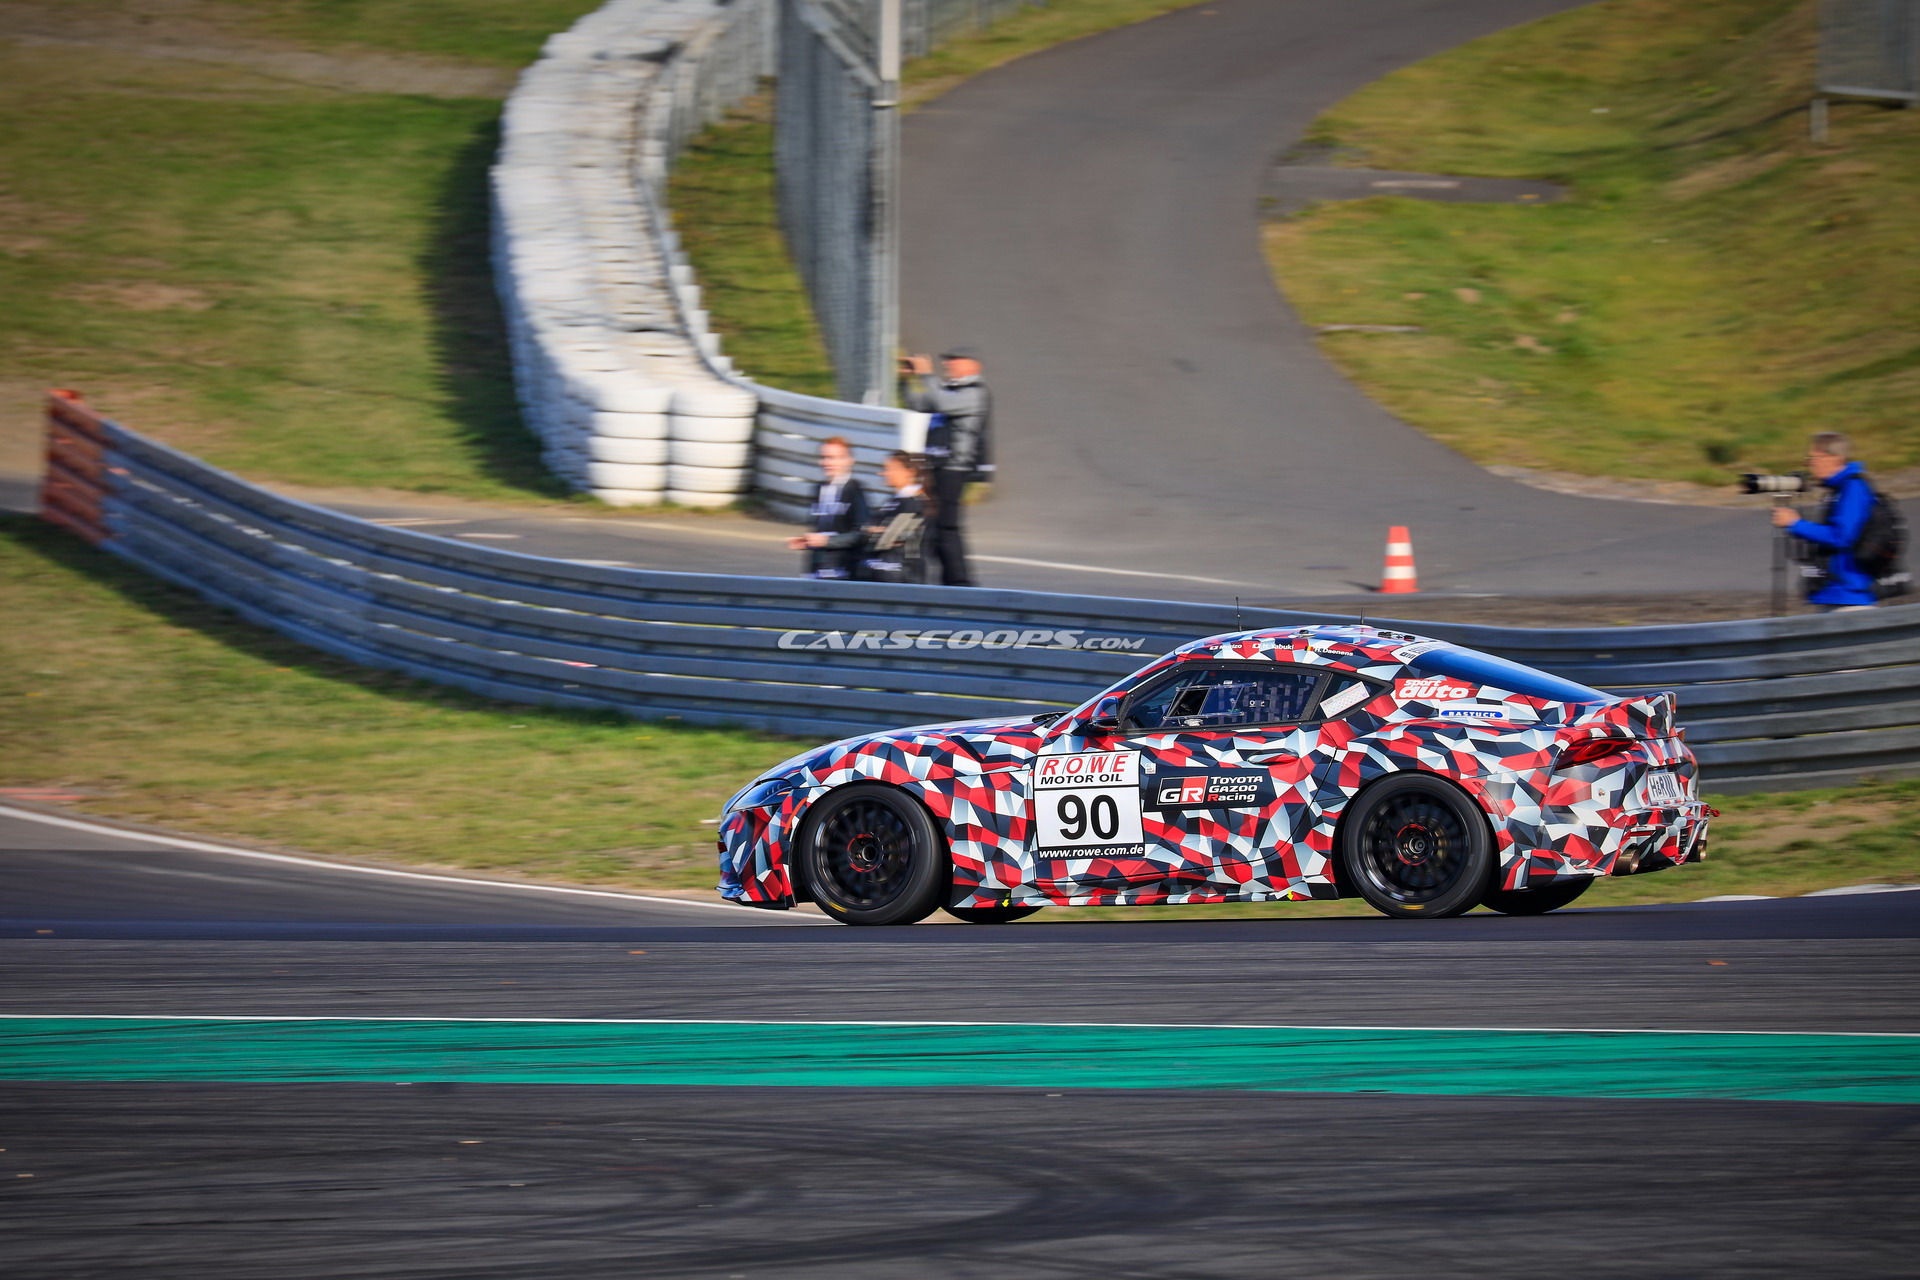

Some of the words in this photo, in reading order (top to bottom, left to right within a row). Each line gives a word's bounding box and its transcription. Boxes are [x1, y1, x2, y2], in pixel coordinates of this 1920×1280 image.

[1403, 679, 1443, 688] sport
[1398, 684, 1470, 699] auto
[1040, 754, 1130, 775] ROWE
[1040, 775, 1094, 785] MOTOR
[1098, 773, 1123, 783] OIL
[1210, 775, 1263, 785] TOYOTA
[1160, 787, 1204, 803] GR
[1208, 784, 1258, 794] GAZOO
[1207, 793, 1256, 803] Racing
[1056, 794, 1120, 840] 90
[1039, 844, 1144, 859] www.rowe.com.de
